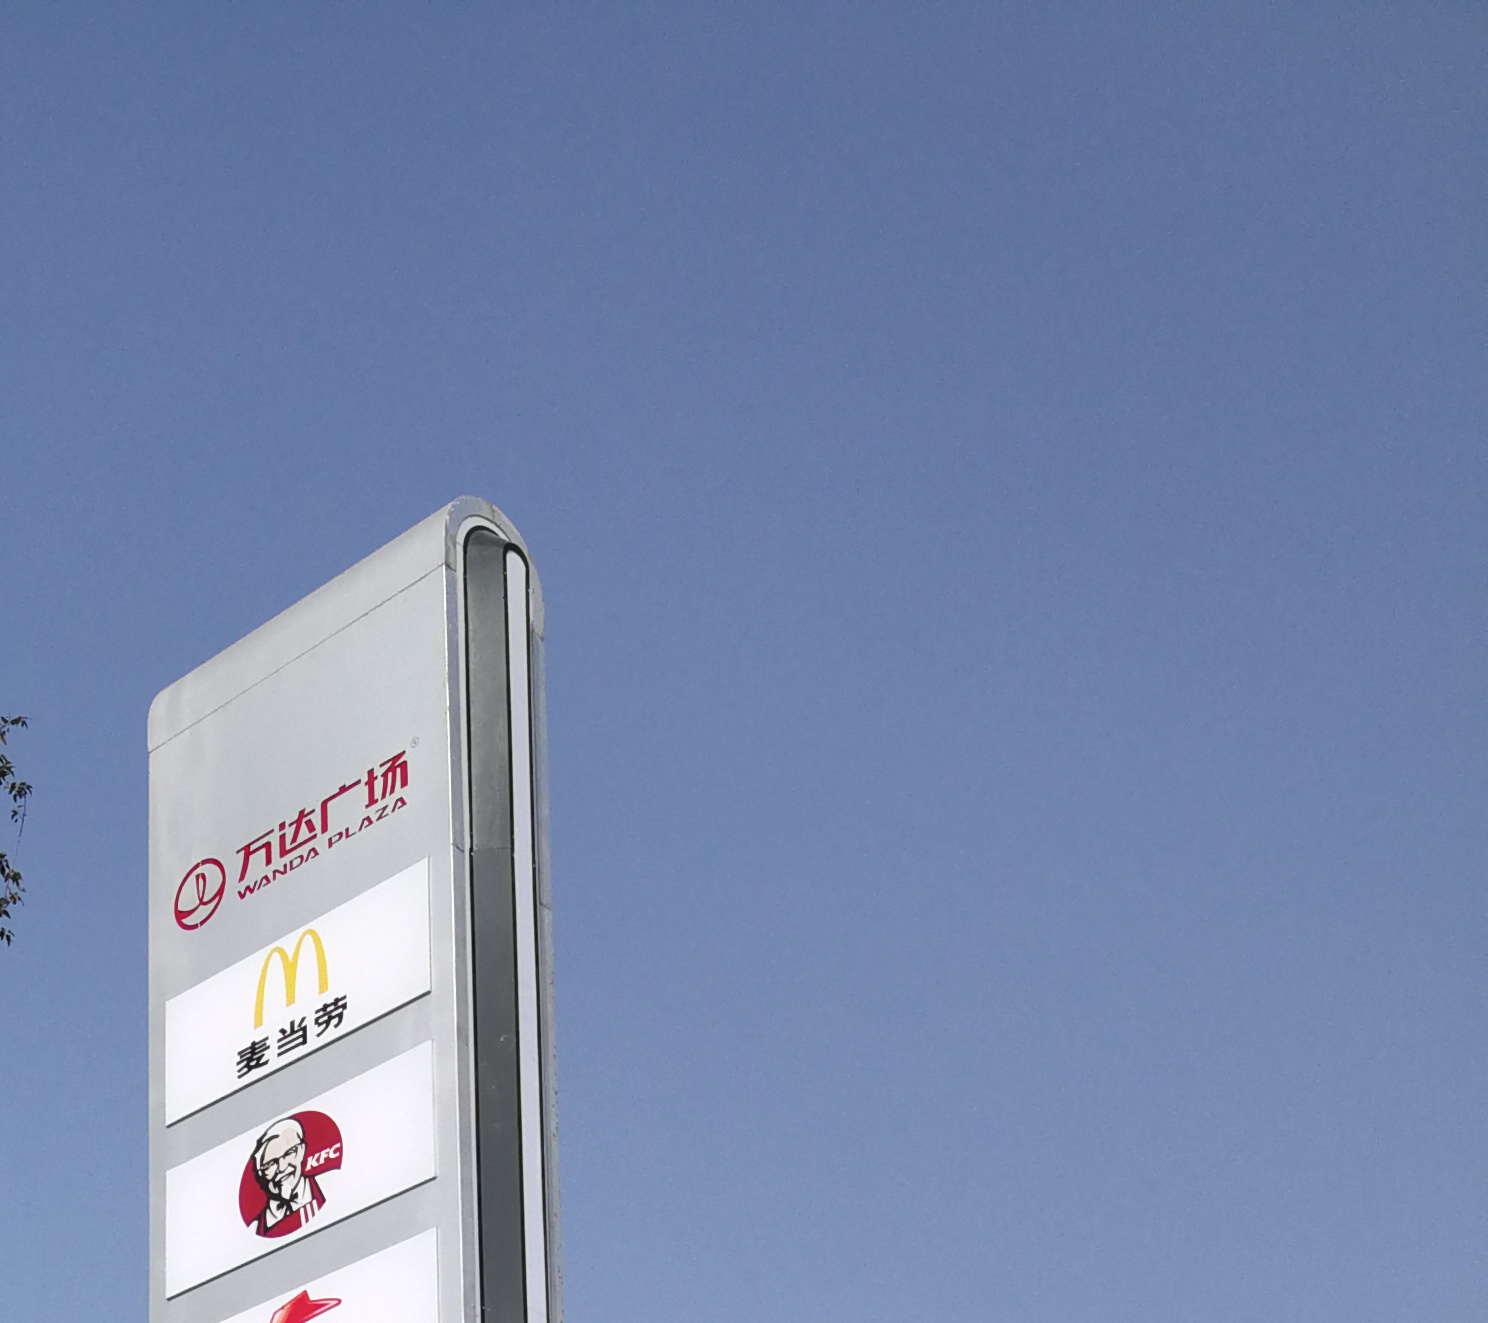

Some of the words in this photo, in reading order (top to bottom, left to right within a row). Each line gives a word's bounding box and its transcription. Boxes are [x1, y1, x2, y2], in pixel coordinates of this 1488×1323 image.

[236, 750, 409, 883] 万达广场
[237, 847, 320, 900] WANDA
[327, 796, 408, 849] PLAZA
[236, 995, 348, 1079] 麦当劳
[305, 1142, 341, 1171] KFC
